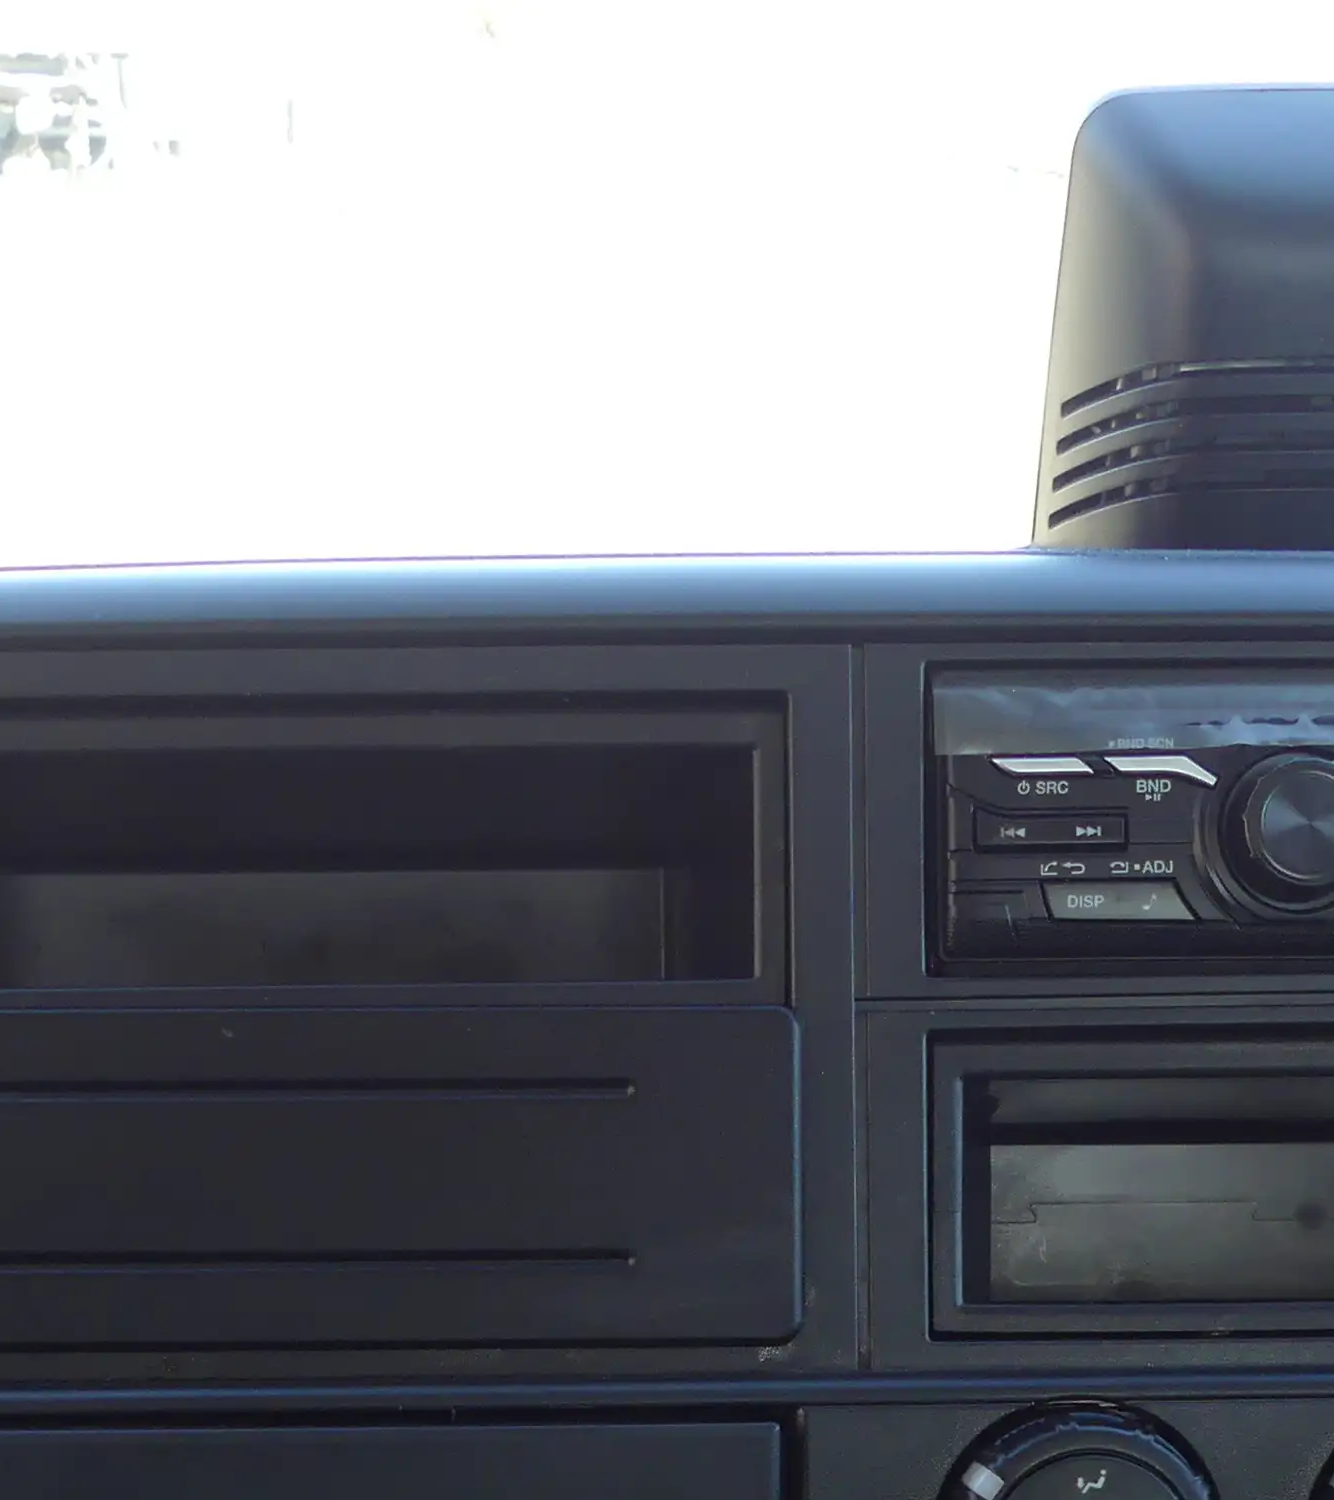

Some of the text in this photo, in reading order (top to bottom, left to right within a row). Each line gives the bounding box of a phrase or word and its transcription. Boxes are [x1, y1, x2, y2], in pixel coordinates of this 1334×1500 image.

[1035, 781, 1069, 795] SRC
[1136, 779, 1172, 793] BND
[1142, 861, 1173, 874] ADJ
[1067, 895, 1105, 908] DISP
